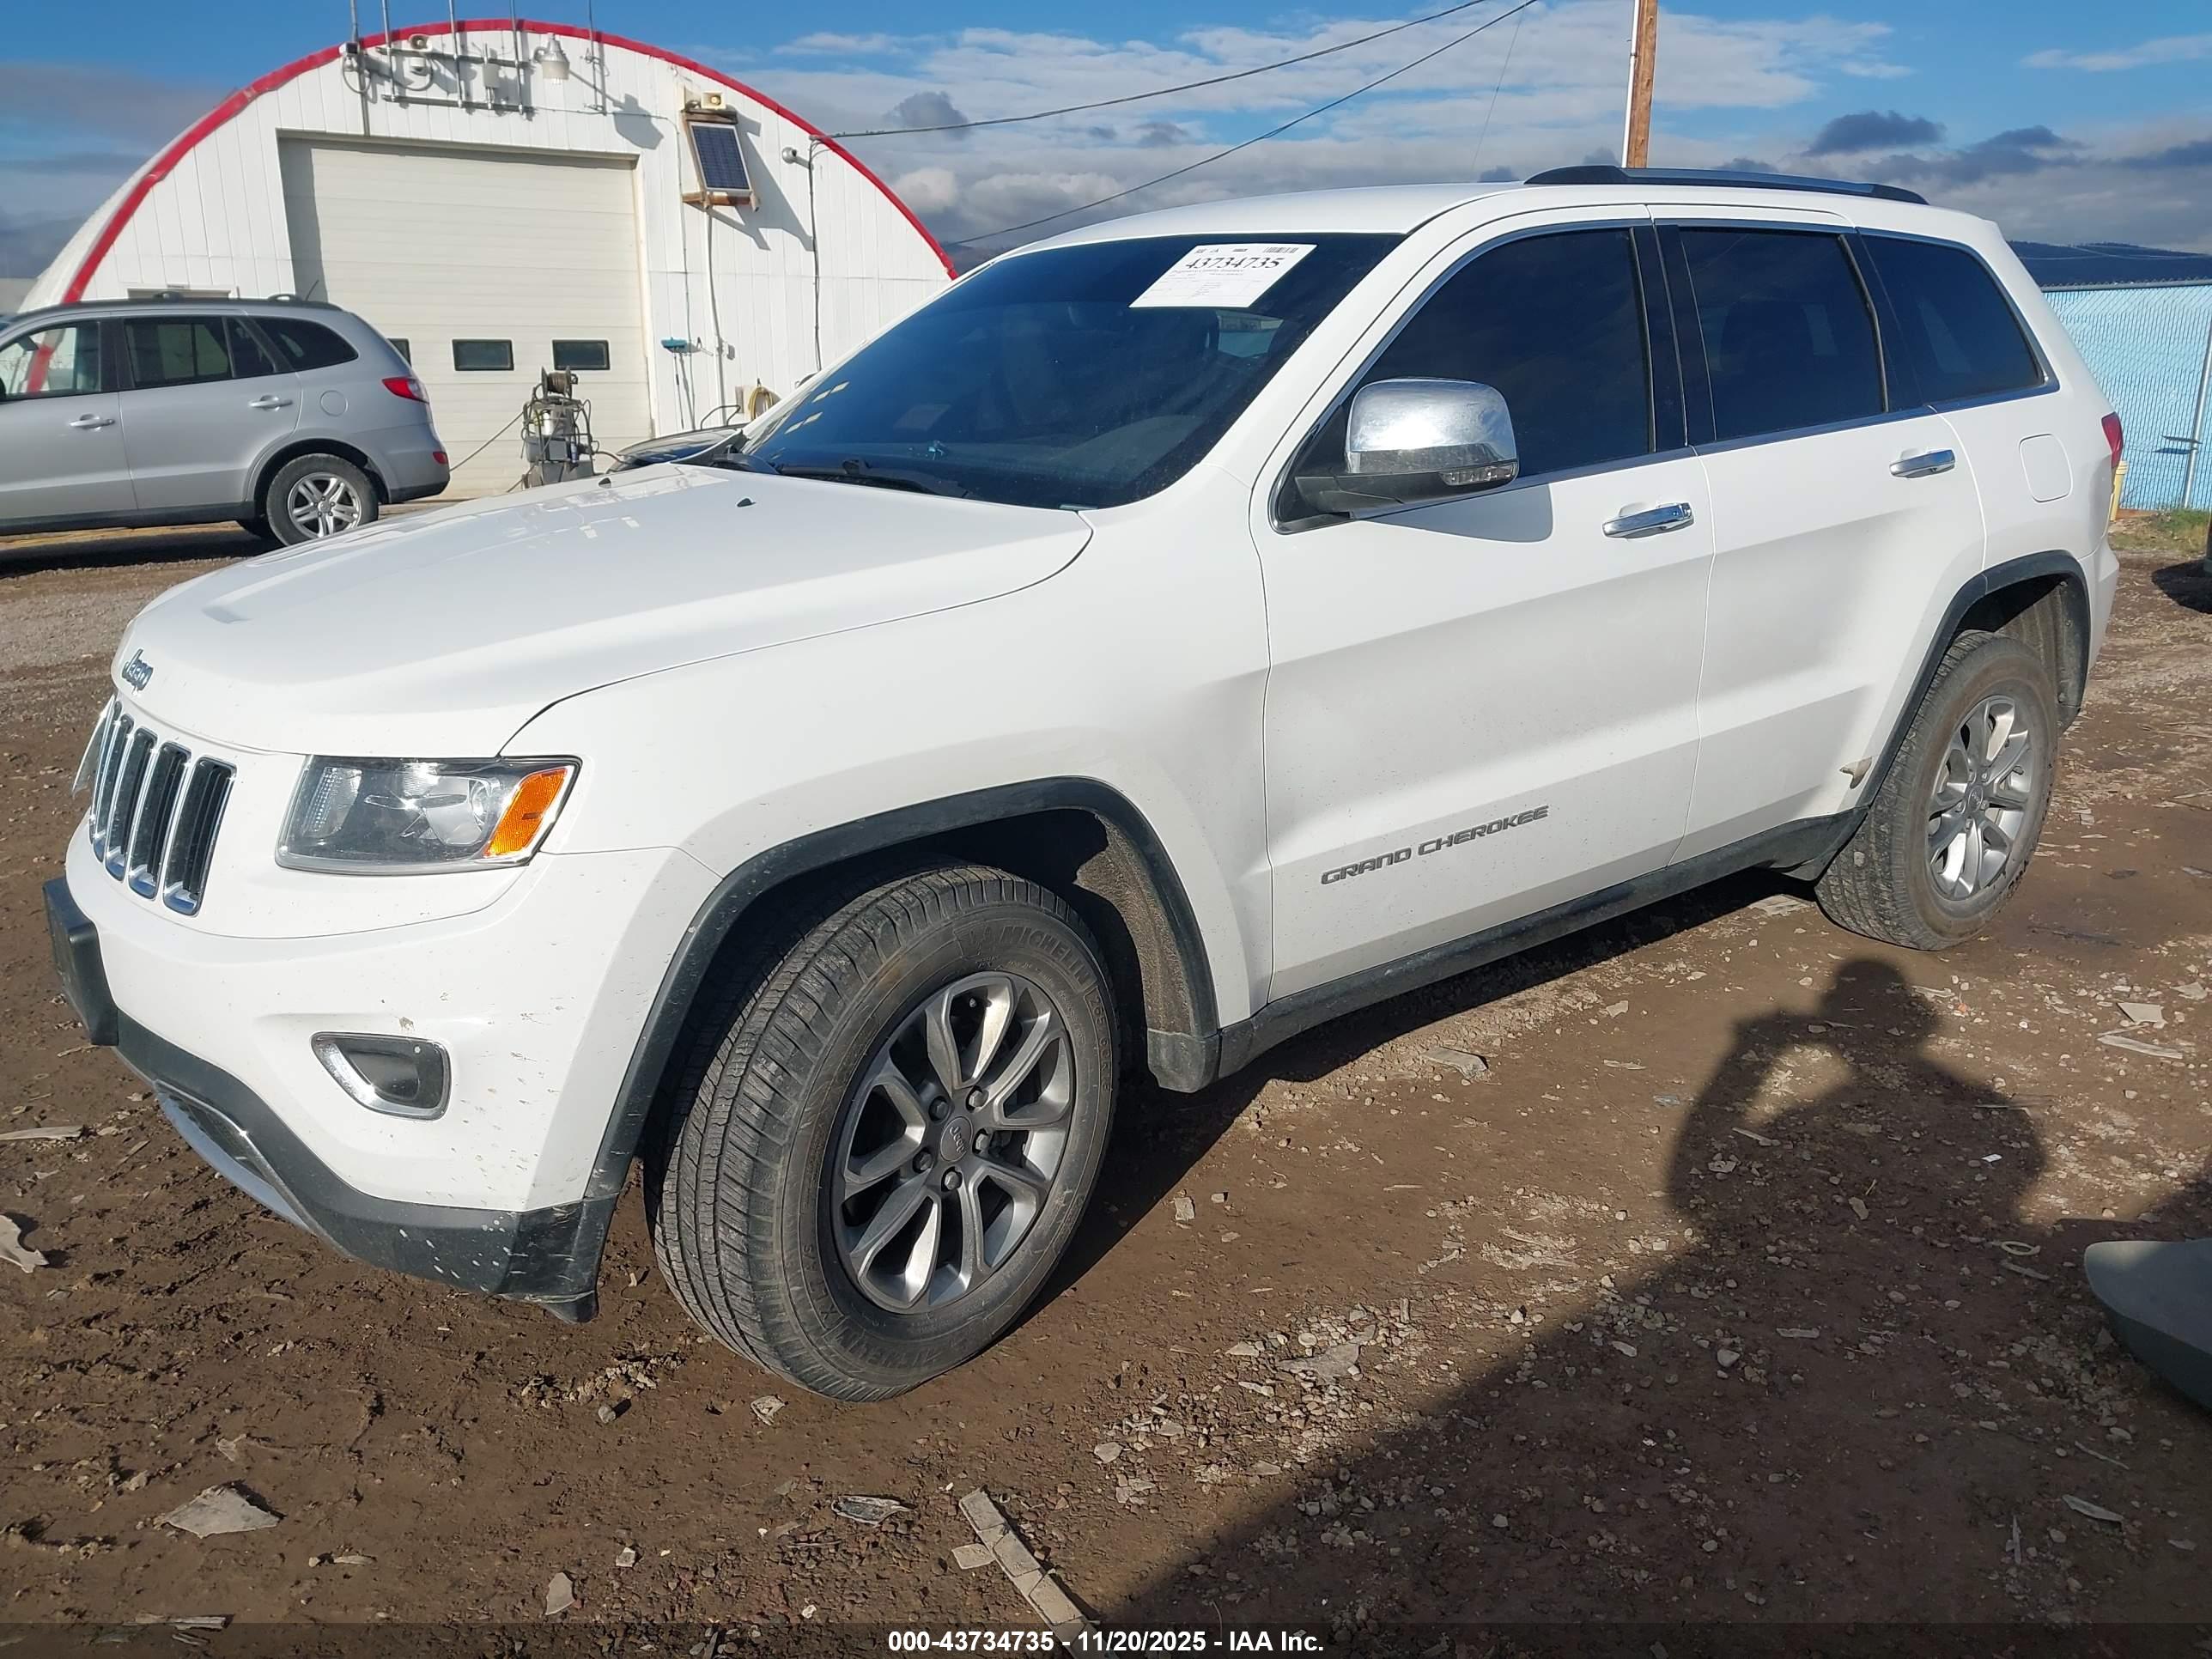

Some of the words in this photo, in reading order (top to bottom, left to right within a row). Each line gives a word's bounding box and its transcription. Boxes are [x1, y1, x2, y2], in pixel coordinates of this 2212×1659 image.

[1186, 257, 1285, 269] 43734735
[122, 648, 154, 694] Jeep
[1321, 848, 1411, 884] GRAND
[1418, 805, 1549, 856] CHEROKEE
[999, 926, 1093, 986] MICHELIN
[949, 1126, 967, 1155] Jeep
